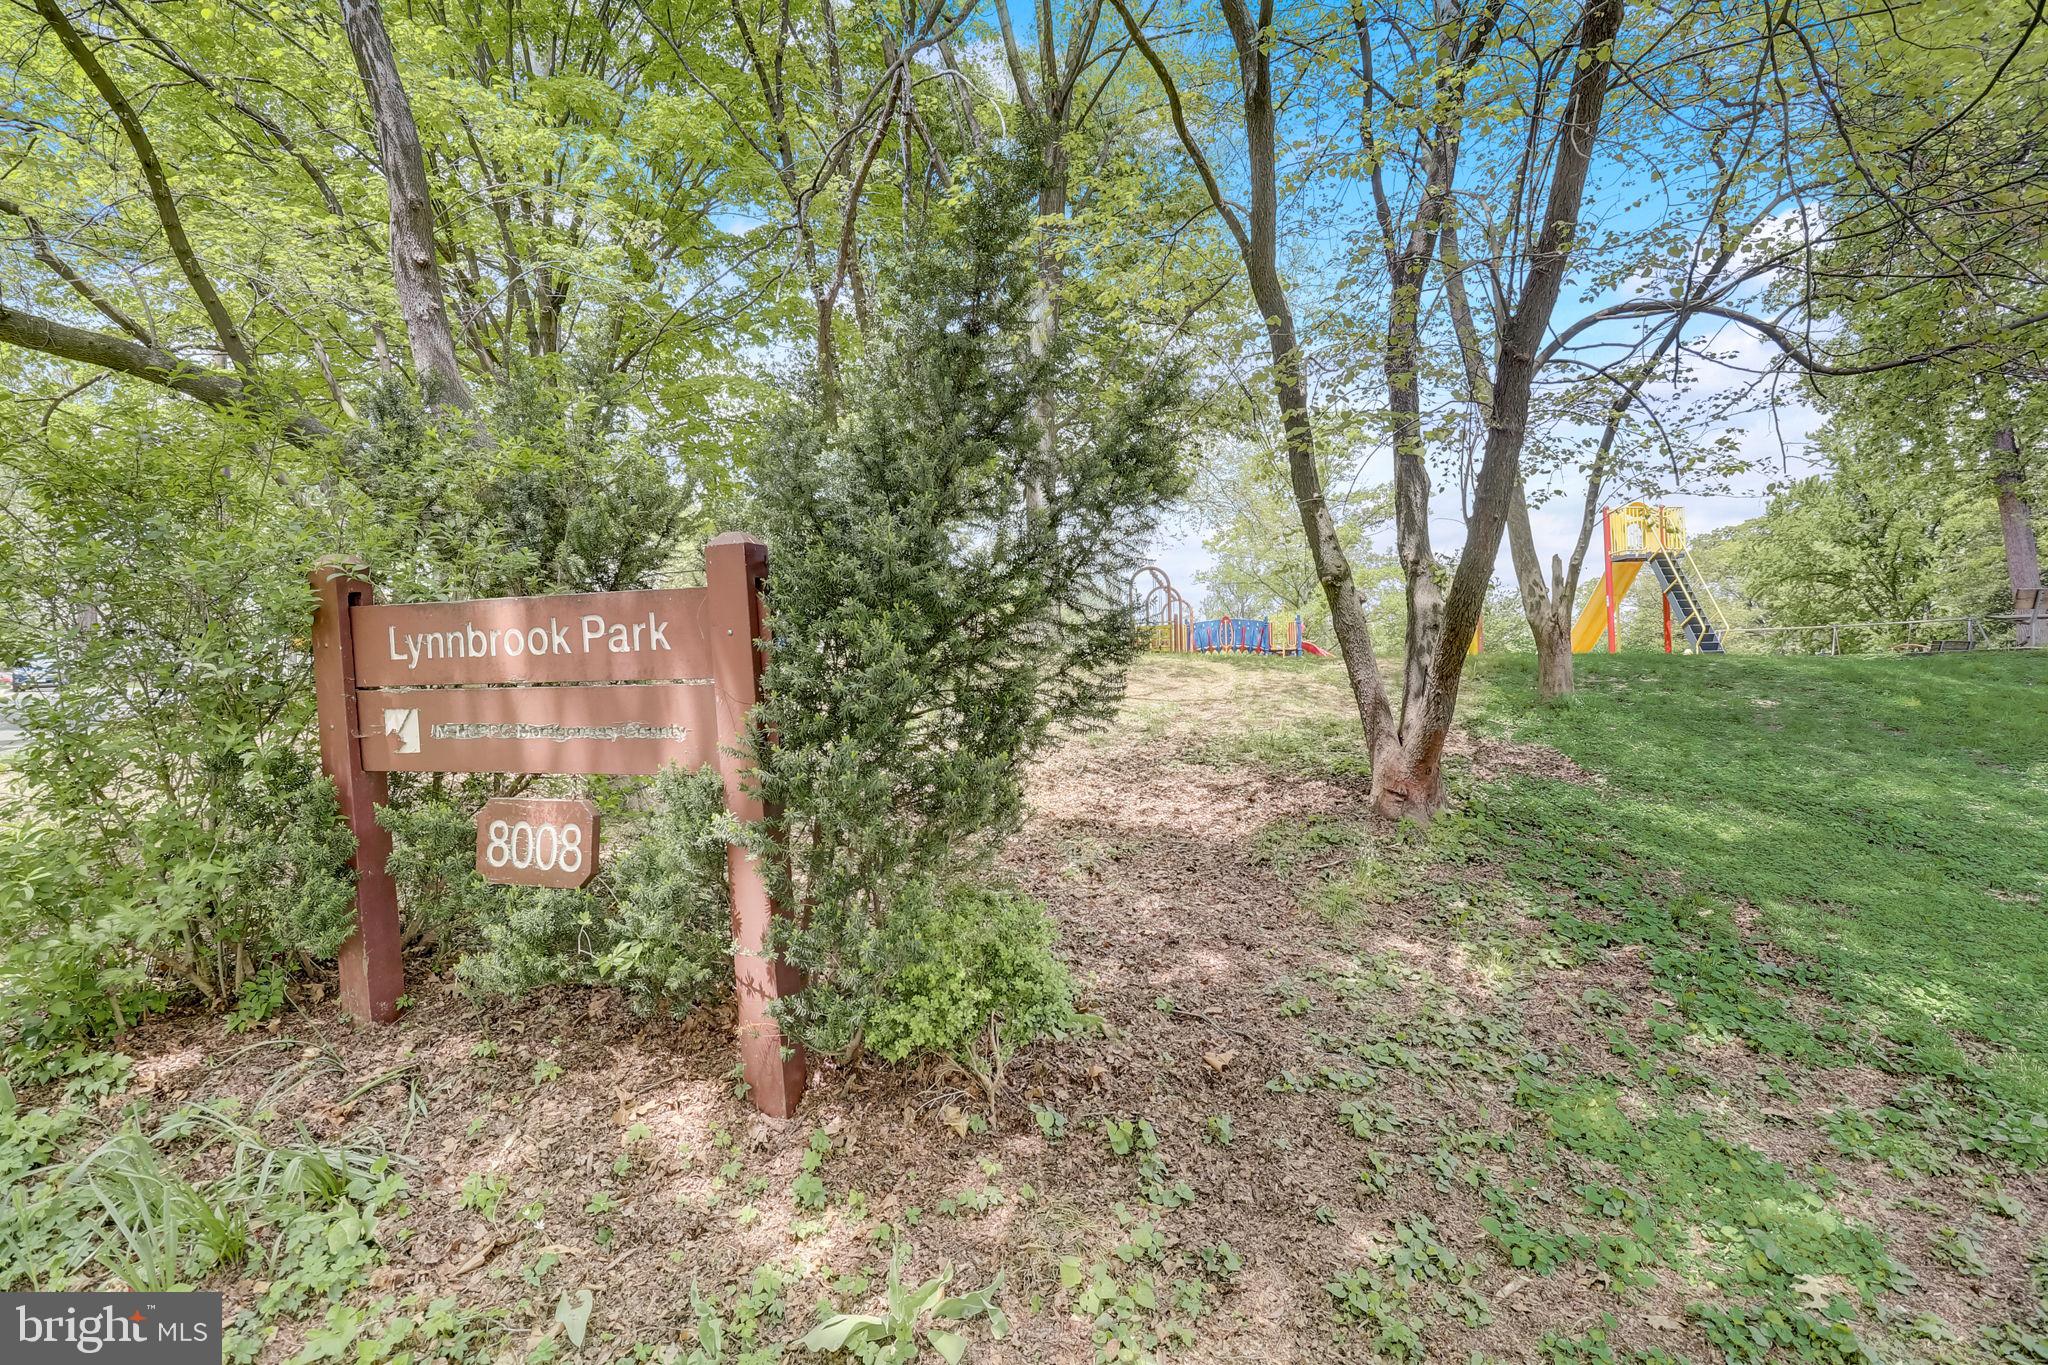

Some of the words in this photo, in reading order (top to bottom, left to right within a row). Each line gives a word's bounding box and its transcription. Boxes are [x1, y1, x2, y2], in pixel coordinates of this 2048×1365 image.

[388, 617, 572, 669] Lynnbrook
[580, 612, 671, 653] Park
[486, 819, 582, 873] 8008
